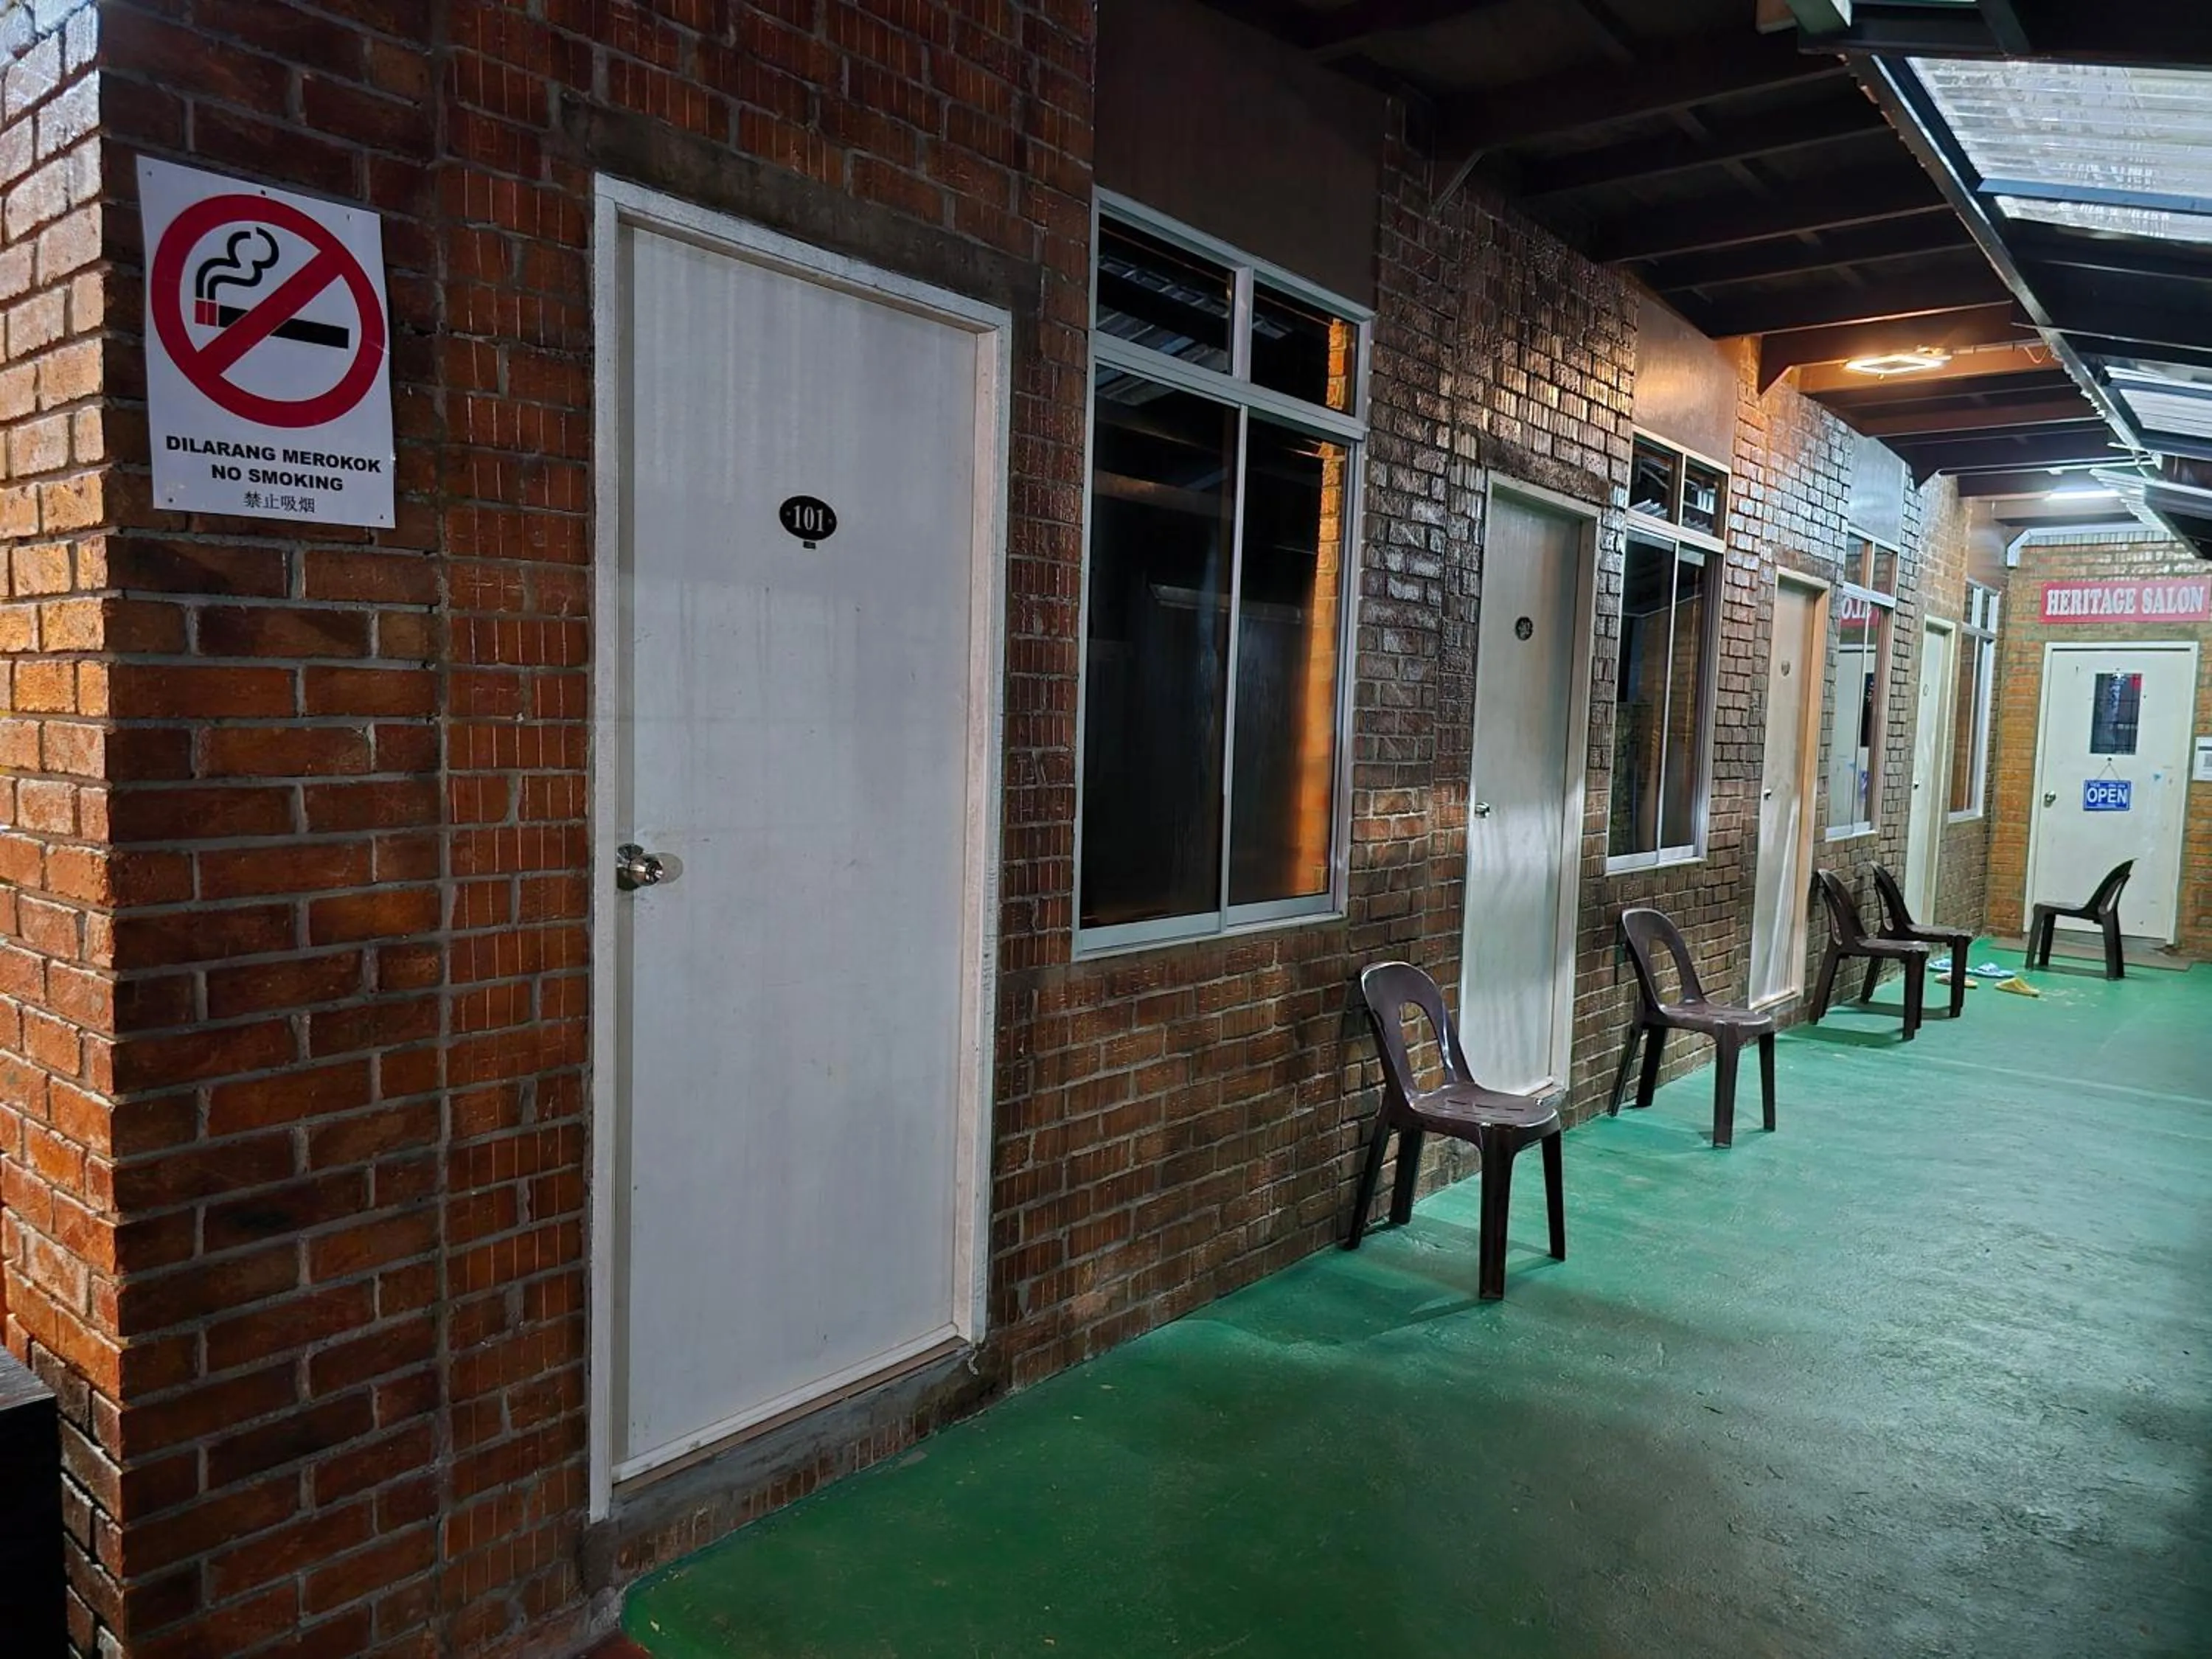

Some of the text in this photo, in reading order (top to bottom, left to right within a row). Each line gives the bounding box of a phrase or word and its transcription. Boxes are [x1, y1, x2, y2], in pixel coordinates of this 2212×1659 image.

[166, 435, 381, 473] DILARANG MEROKOK
[211, 465, 343, 491] NO SMOKING
[244, 491, 316, 513] 禁止吸烟
[793, 505, 824, 532] 101
[2045, 585, 2205, 616] HERITAGE SALON
[2087, 787, 2128, 804] OPEN
